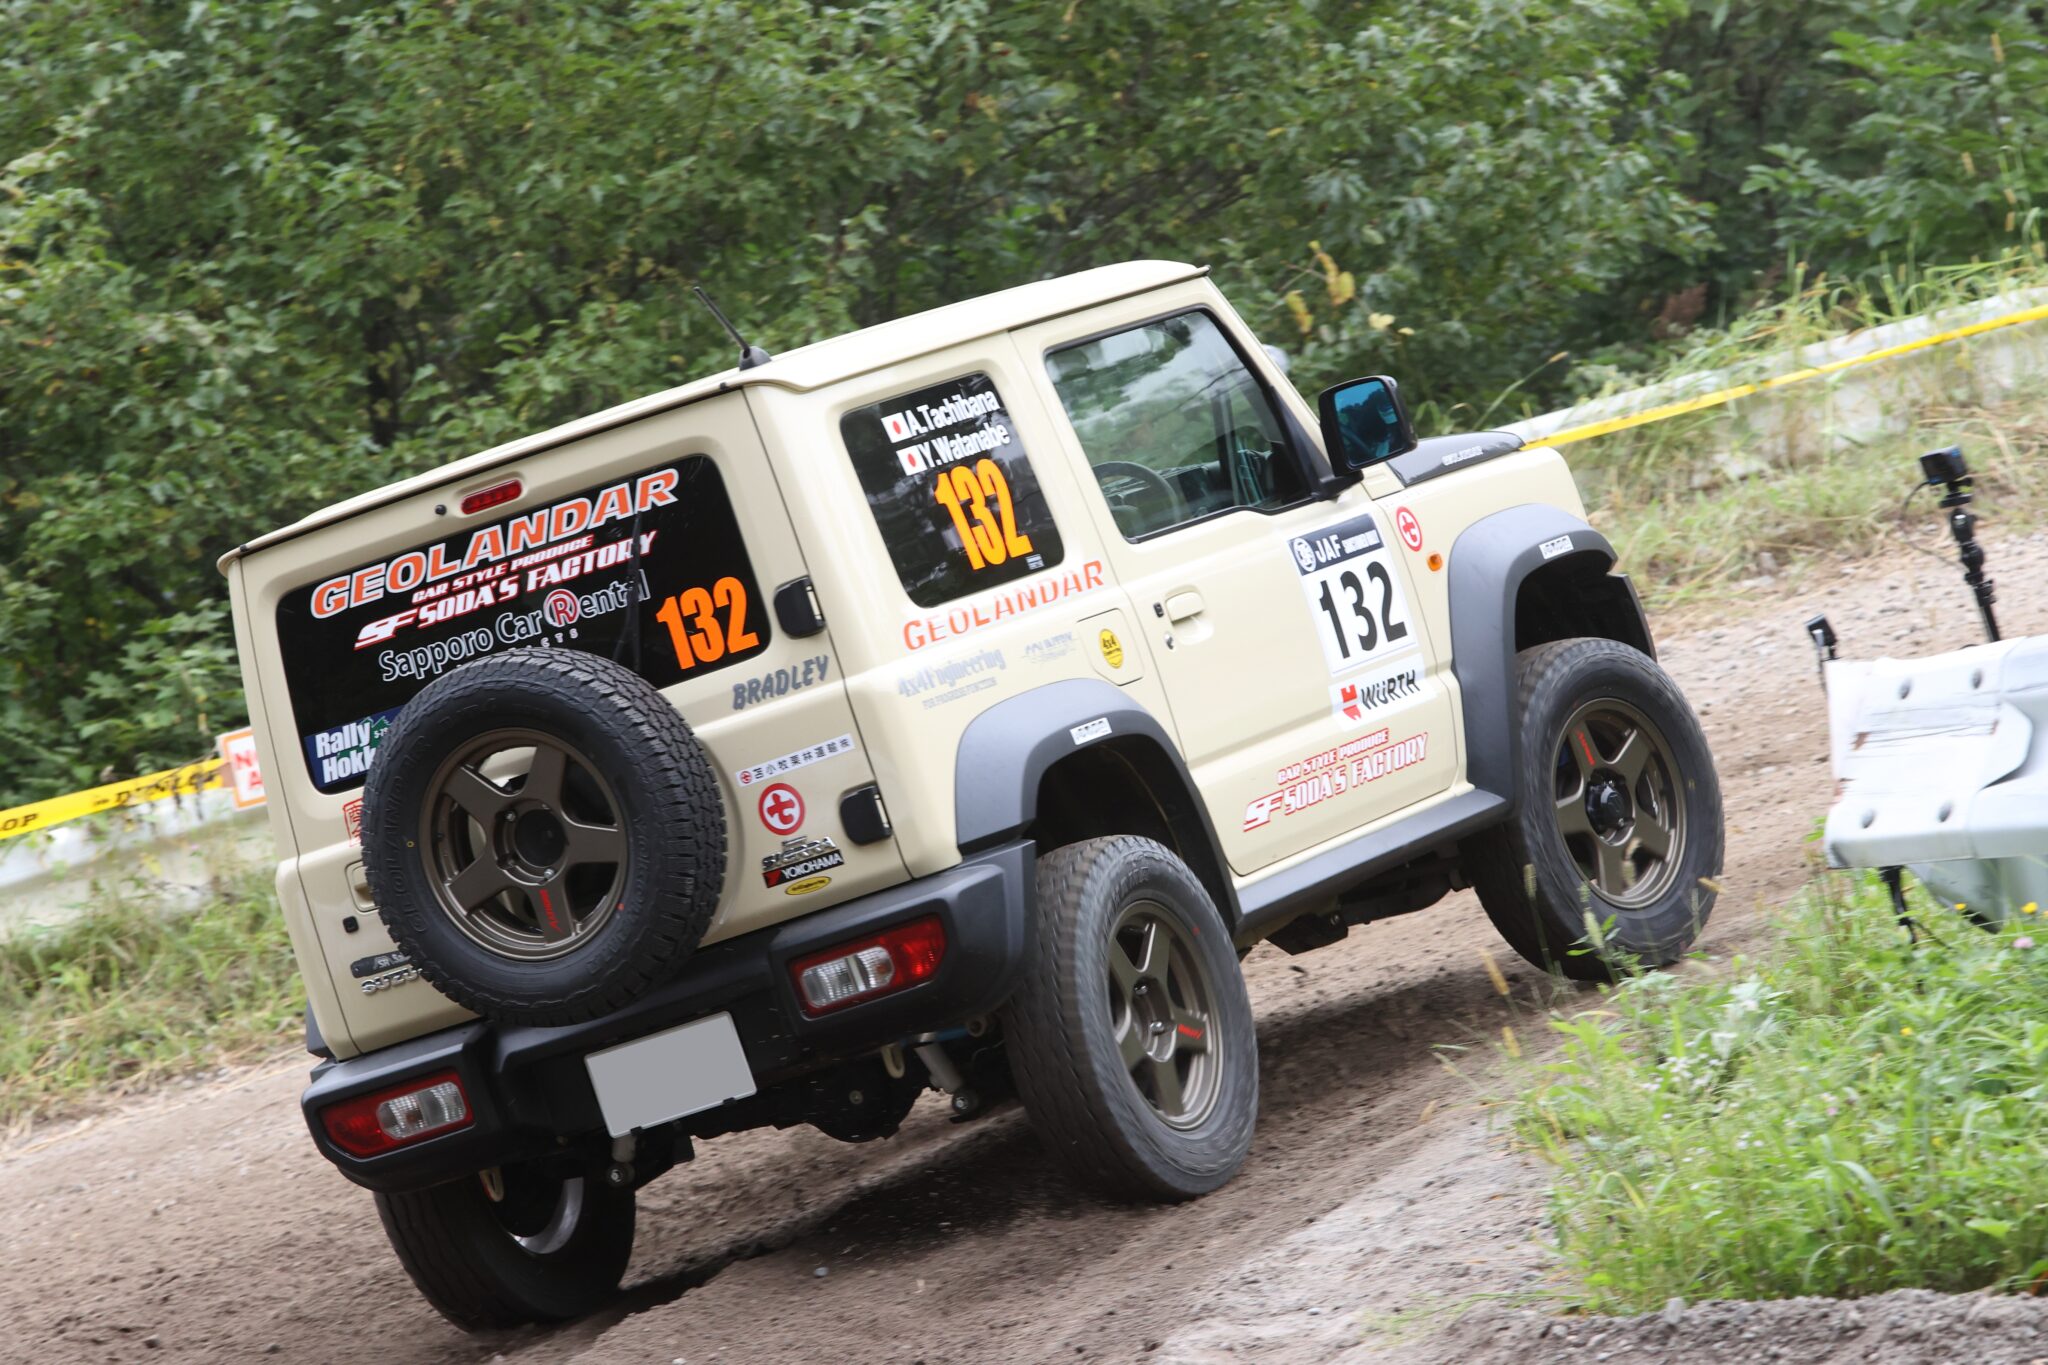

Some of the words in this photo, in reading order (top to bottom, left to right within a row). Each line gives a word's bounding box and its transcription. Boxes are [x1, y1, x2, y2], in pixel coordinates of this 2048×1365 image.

[904, 390, 1000, 437] A.Tachibana
[918, 423, 1010, 468] Y.Watanabe
[311, 468, 679, 619] GEOLANDAR
[934, 458, 1033, 570] 132
[1315, 533, 1341, 563] JAF
[411, 580, 450, 605] CAR
[450, 562, 508, 592] STYLE
[510, 534, 595, 572] PRODUCE
[417, 574, 520, 628] SODA'S
[525, 530, 657, 593] FACTORY
[903, 560, 1104, 650] GEOLANDAR
[655, 576, 760, 671] 132
[1319, 561, 1408, 659] 132
[379, 625, 494, 683] Sapporo
[494, 611, 543, 645] Car
[732, 654, 829, 711] BRADLEY
[315, 722, 371, 759] Rally
[1277, 763, 1301, 785] CAR
[1303, 749, 1337, 776] STYLE
[1338, 727, 1389, 760] PRODUCE
[1284, 764, 1347, 815] SODA'S
[1350, 732, 1428, 788] FACTORY
[781, 852, 842, 879] YOKOHAMA
[361, 967, 423, 995] SUZU
